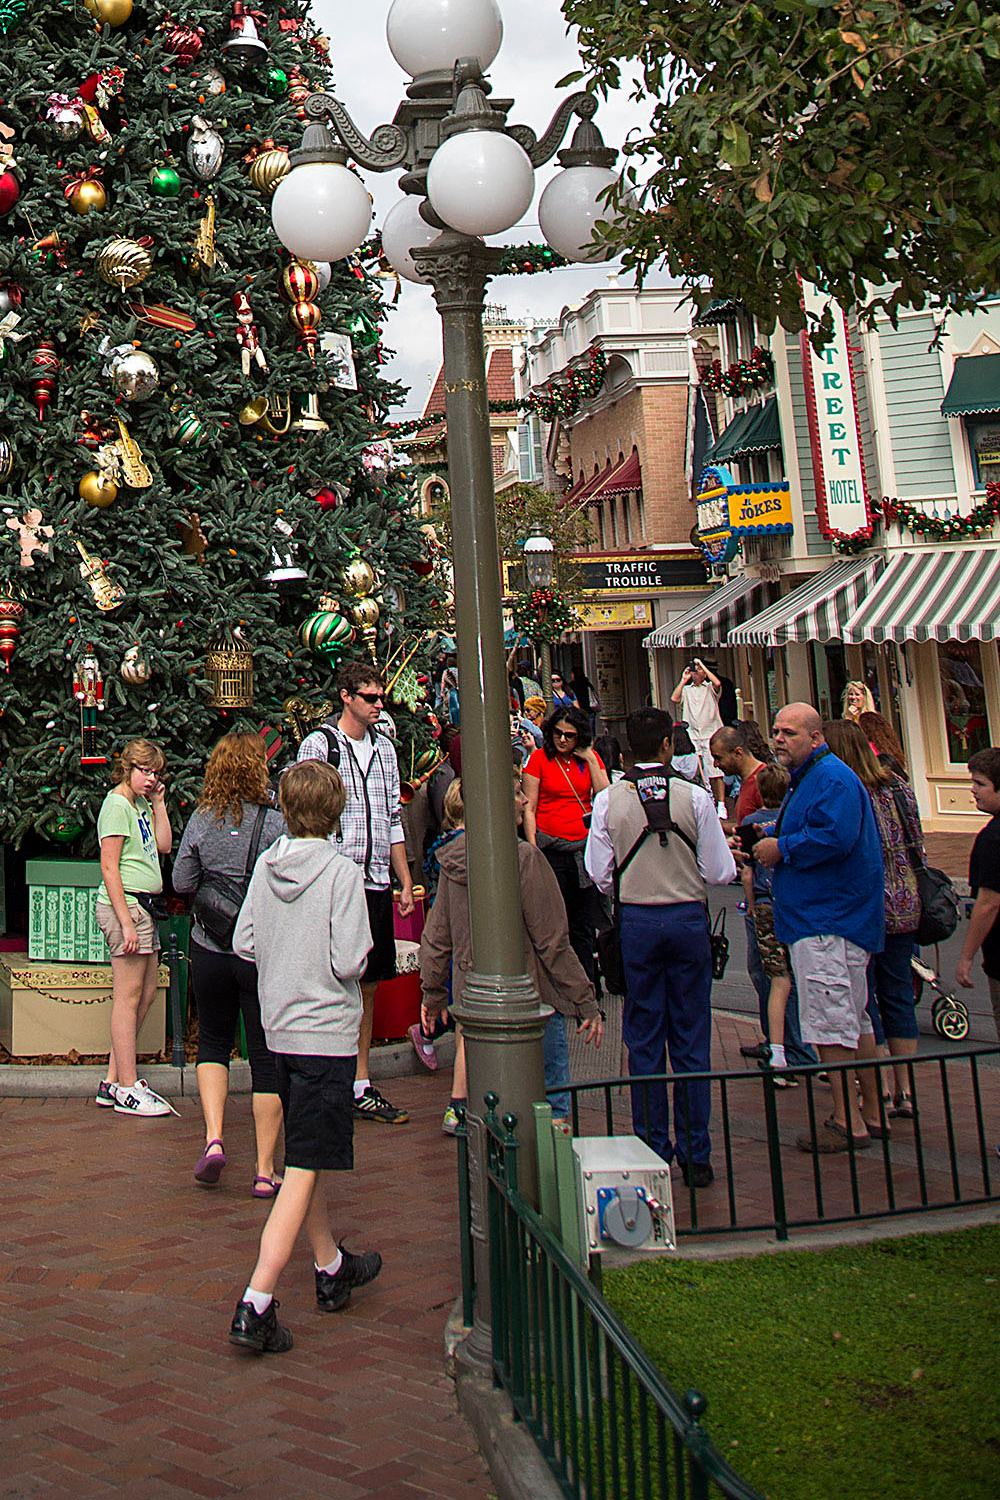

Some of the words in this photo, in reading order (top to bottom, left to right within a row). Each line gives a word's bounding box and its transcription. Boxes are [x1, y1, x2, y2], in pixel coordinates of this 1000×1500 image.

[819, 347, 851, 466] TREET
[829, 479, 861, 504] HOTEL
[739, 498, 782, 520] JOKES
[606, 562, 657, 574] TRAFFIC
[605, 575, 662, 587] TROUBLE
